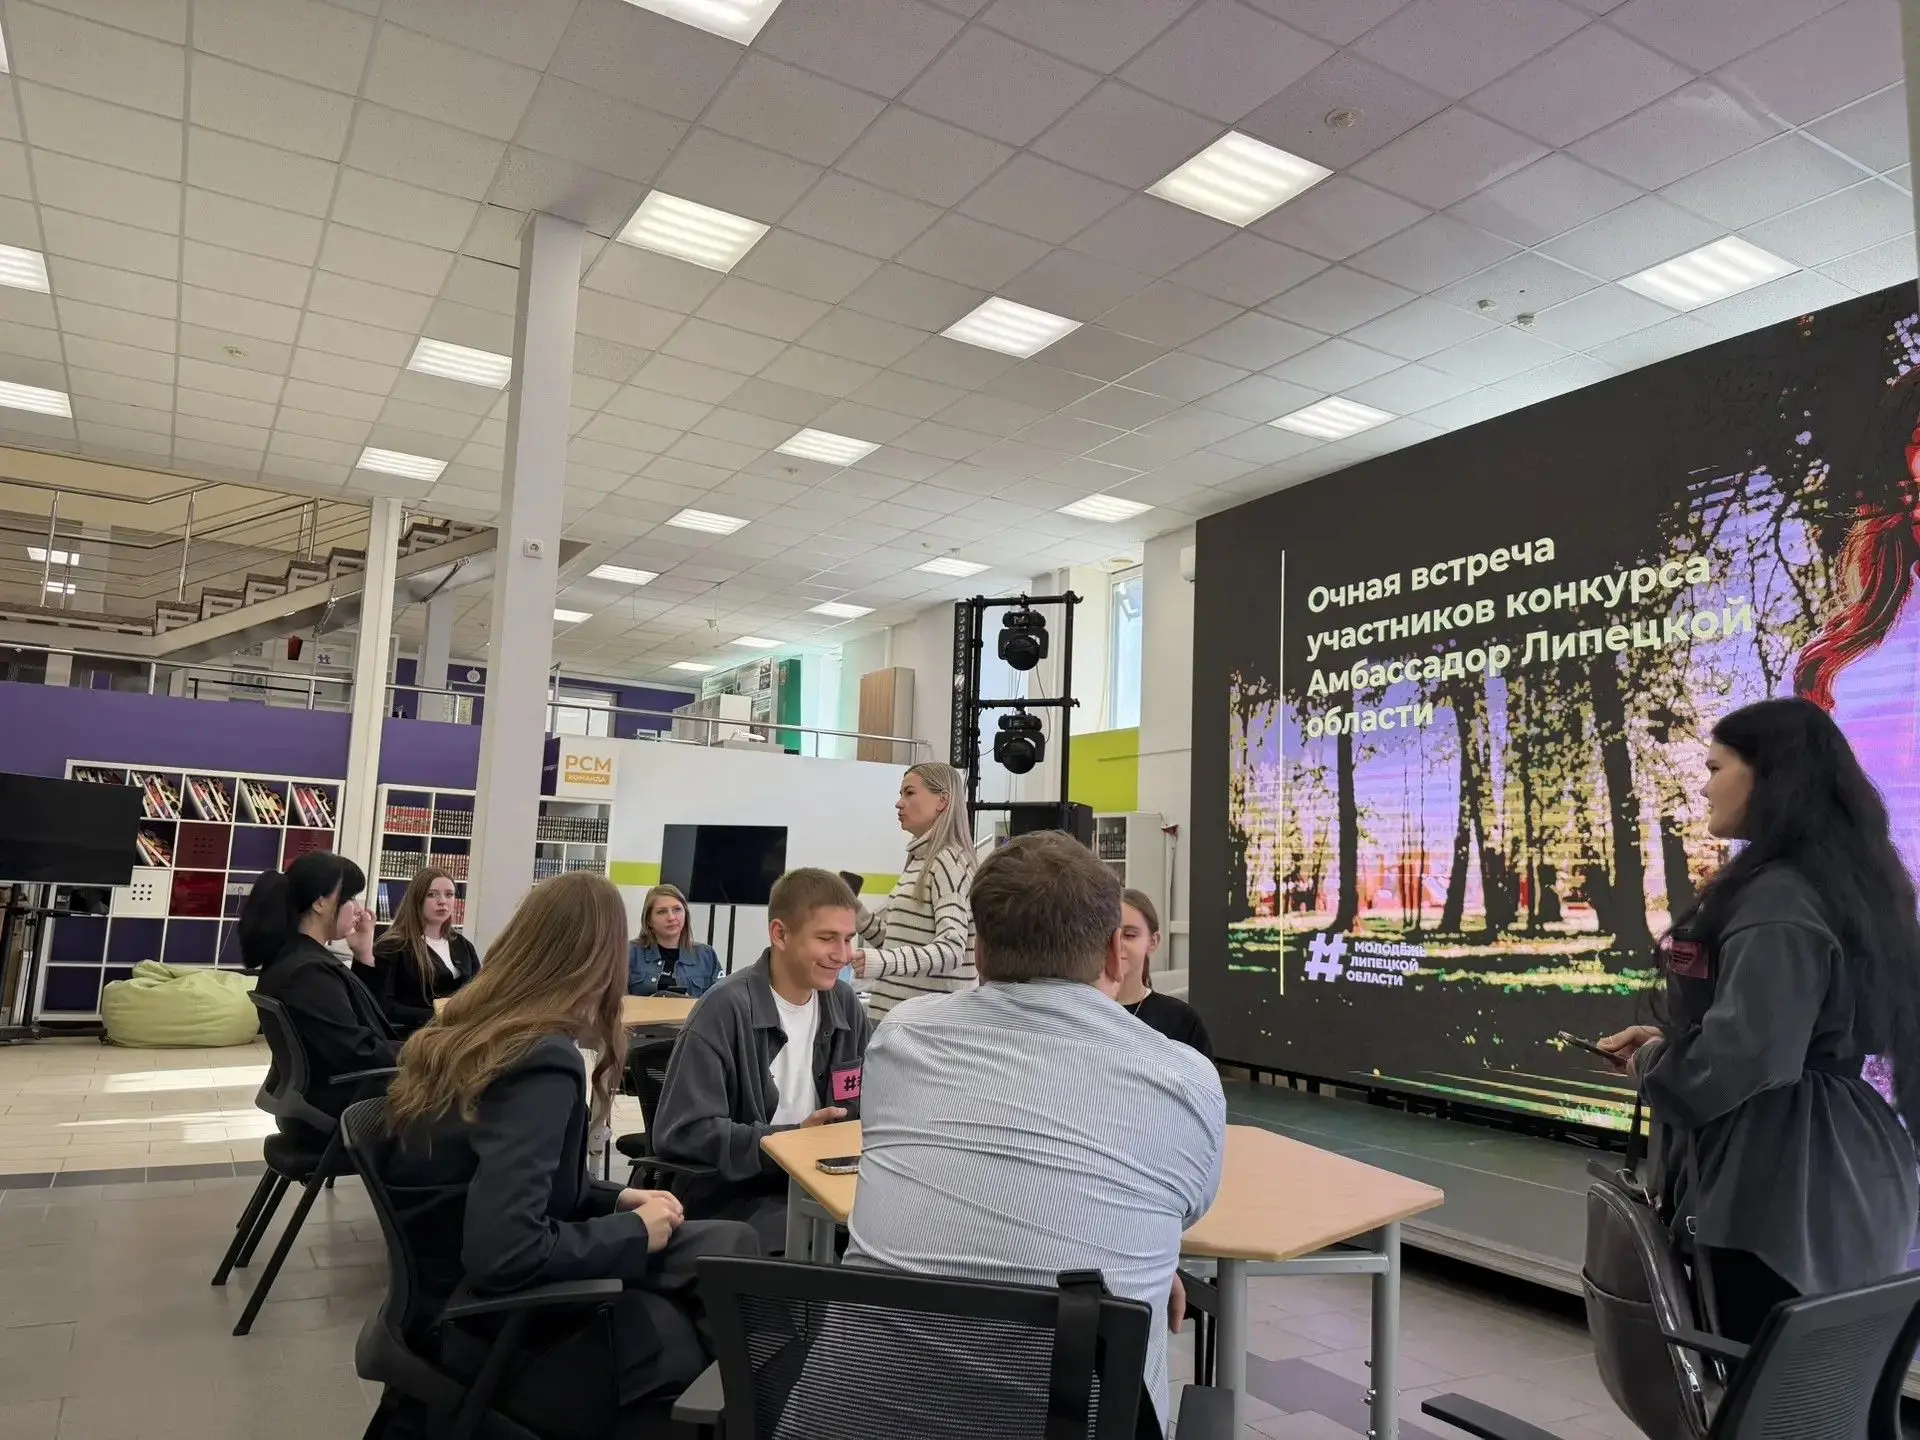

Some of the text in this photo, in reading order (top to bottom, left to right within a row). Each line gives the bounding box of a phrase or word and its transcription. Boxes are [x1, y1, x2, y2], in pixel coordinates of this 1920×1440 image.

[1307, 536, 1556, 613] Очная встреча
[1306, 553, 1712, 662] участников конкурса
[1306, 596, 1754, 697] Амбассадор Липецкой
[1306, 699, 1434, 738] области
[565, 755, 612, 773] РСМ
[1346, 971, 1403, 986] ОБЛАСТИ
[1350, 956, 1419, 972] ЛИПЕЦКОЙ
